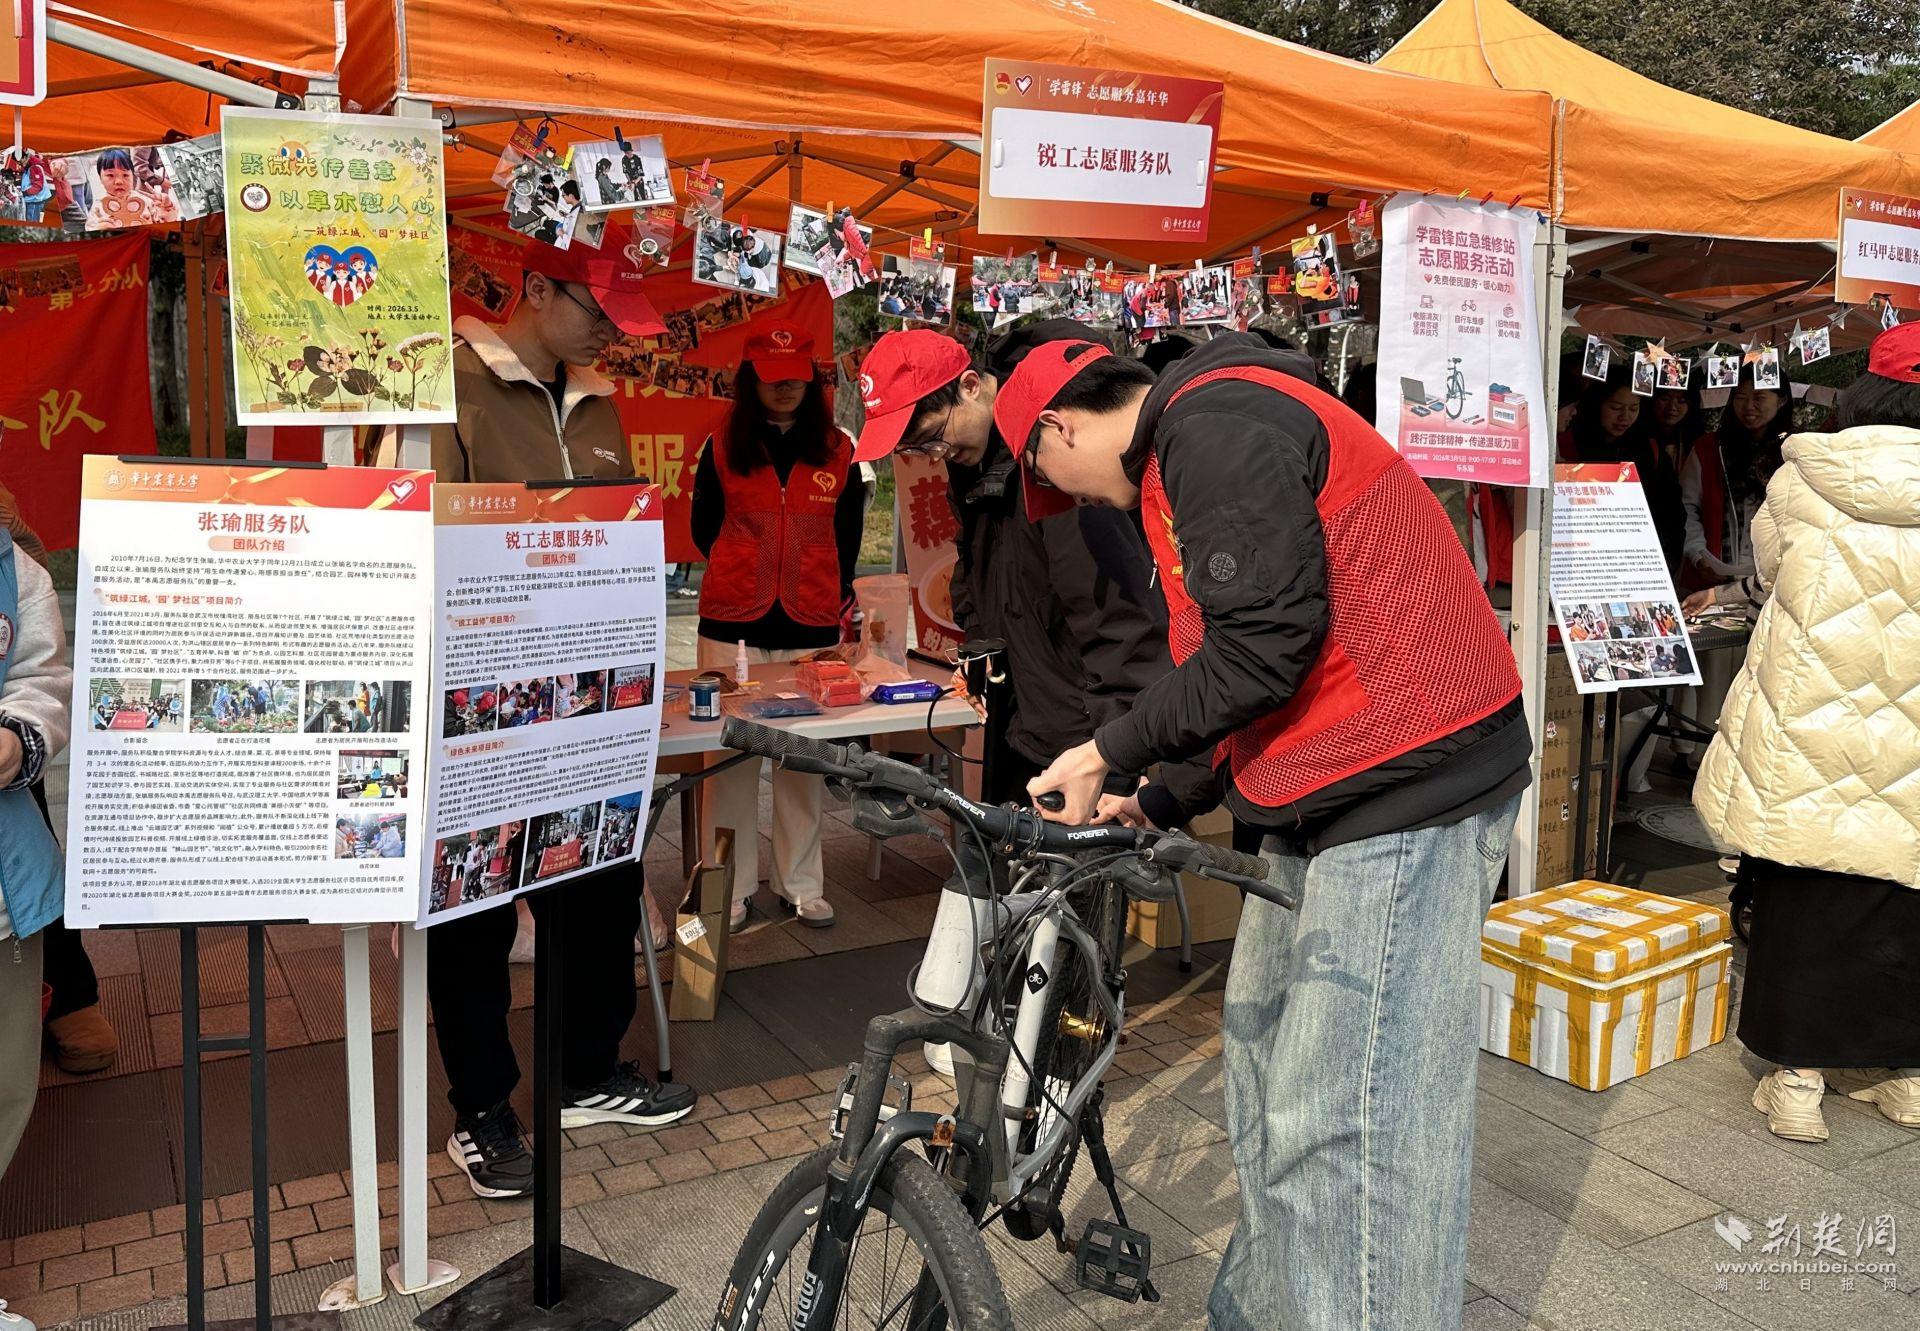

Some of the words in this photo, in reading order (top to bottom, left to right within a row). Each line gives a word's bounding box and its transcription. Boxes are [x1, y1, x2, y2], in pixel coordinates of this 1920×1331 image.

[240, 152, 396, 182] 聚微光传善意
[1037, 143, 1172, 176] 锐工志愿服务队
[279, 189, 435, 215] 以草木慰人心
[1416, 225, 1515, 255] 学雷锋应急维修站
[1418, 247, 1514, 278] 志愿服务活动
[1858, 241, 1920, 266] 红马甲志愿服务
[1454, 315, 1484, 326] 自行车维修
[1409, 433, 1520, 450] 践行雷锋精神·传递温暖力量
[197, 511, 311, 535] 张瑜服务队
[232, 537, 285, 552] 团队介绍
[505, 528, 609, 550] 锐工志愿服务队
[542, 553, 576, 565] 团队介绍
[1066, 828, 1110, 841] FOREVER
